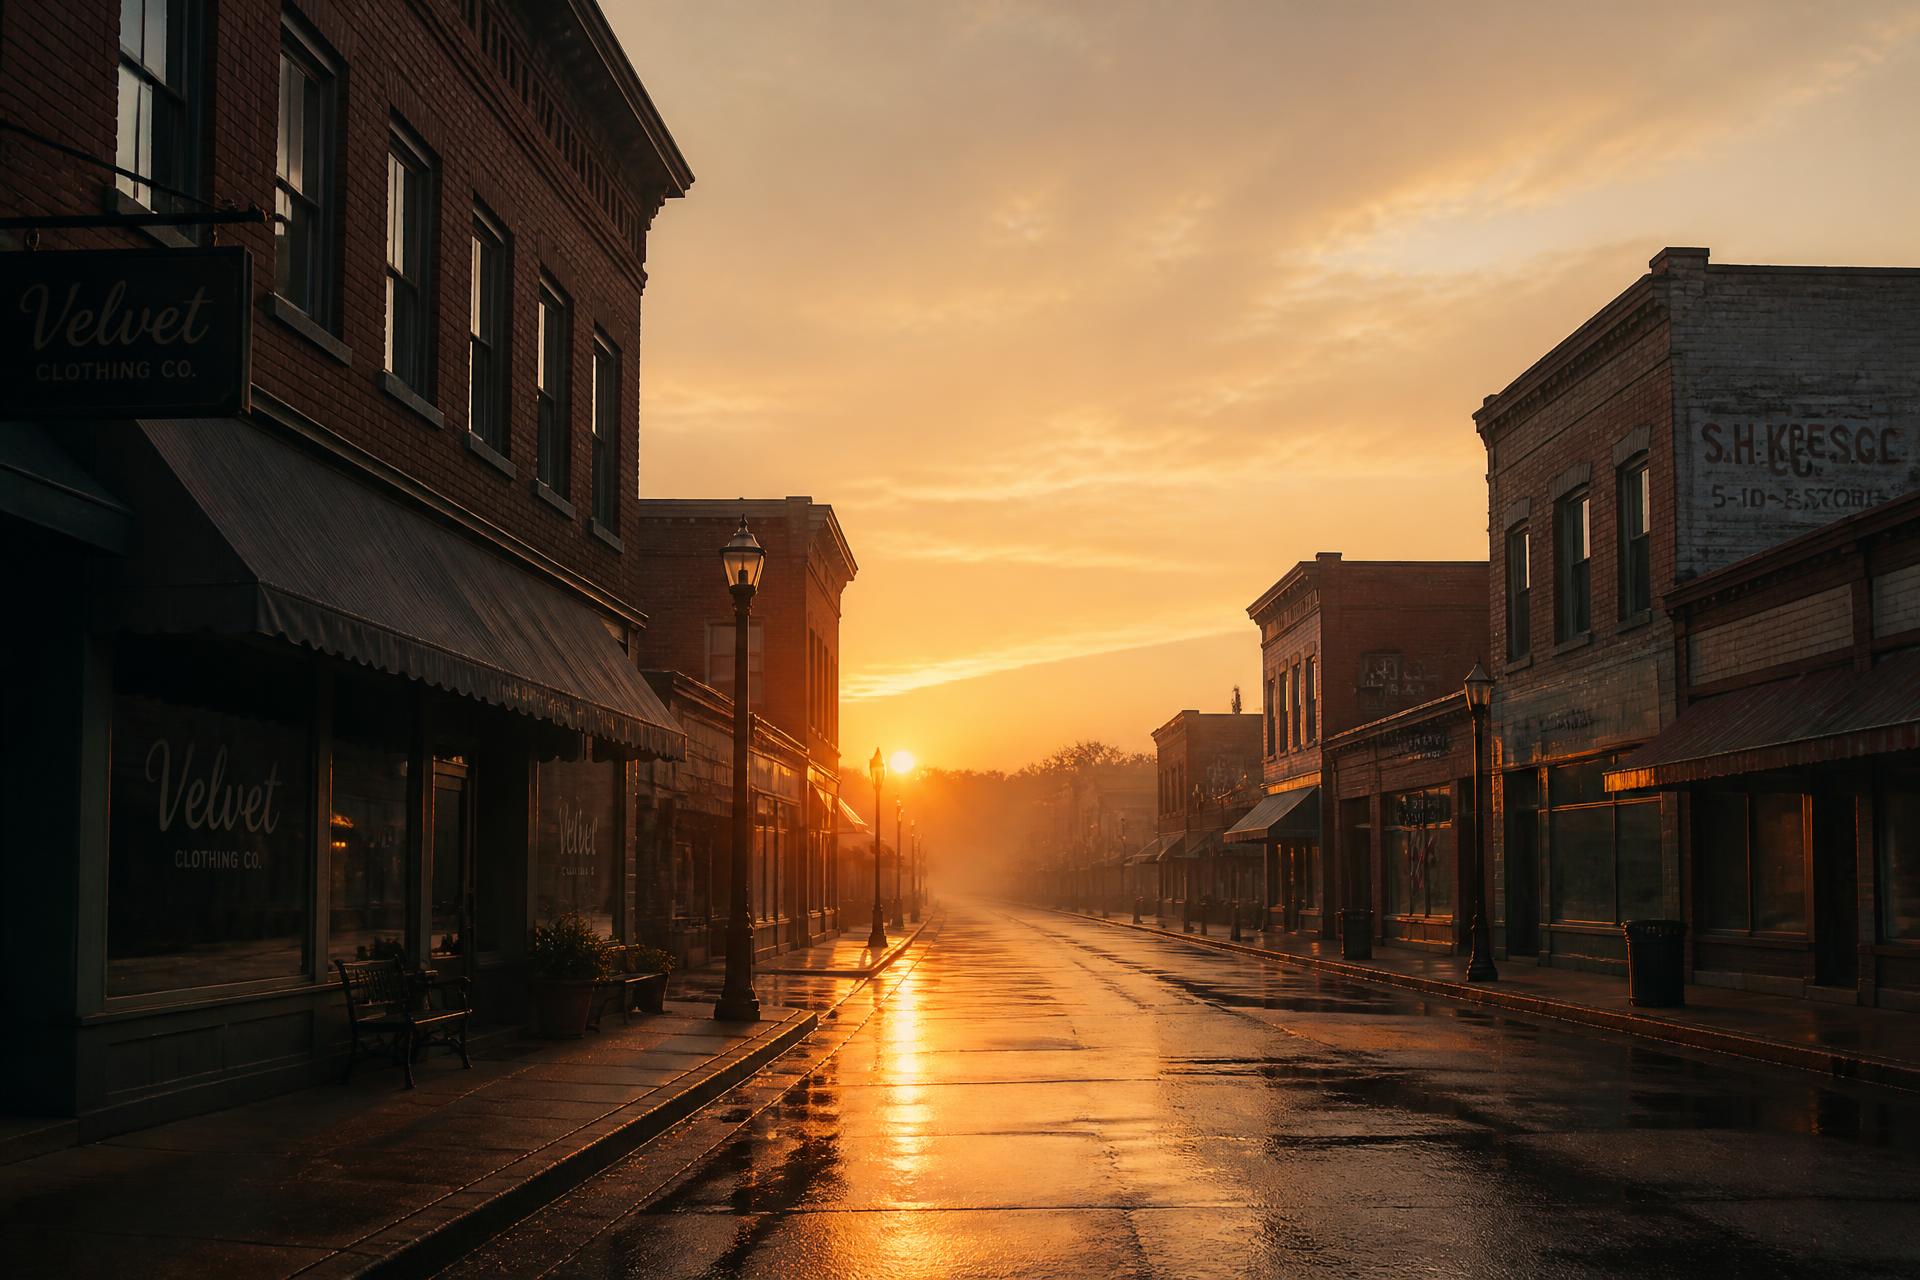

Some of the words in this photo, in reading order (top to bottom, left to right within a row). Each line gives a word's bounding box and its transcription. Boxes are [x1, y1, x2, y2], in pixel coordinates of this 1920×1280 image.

[19, 280, 215, 351] Velvet
[35, 360, 151, 382] CLOTHING
[161, 359, 198, 379] CO.
[145, 737, 282, 835] Velvet
[174, 849, 239, 869] CLOTHING
[244, 849, 263, 869] CO.
